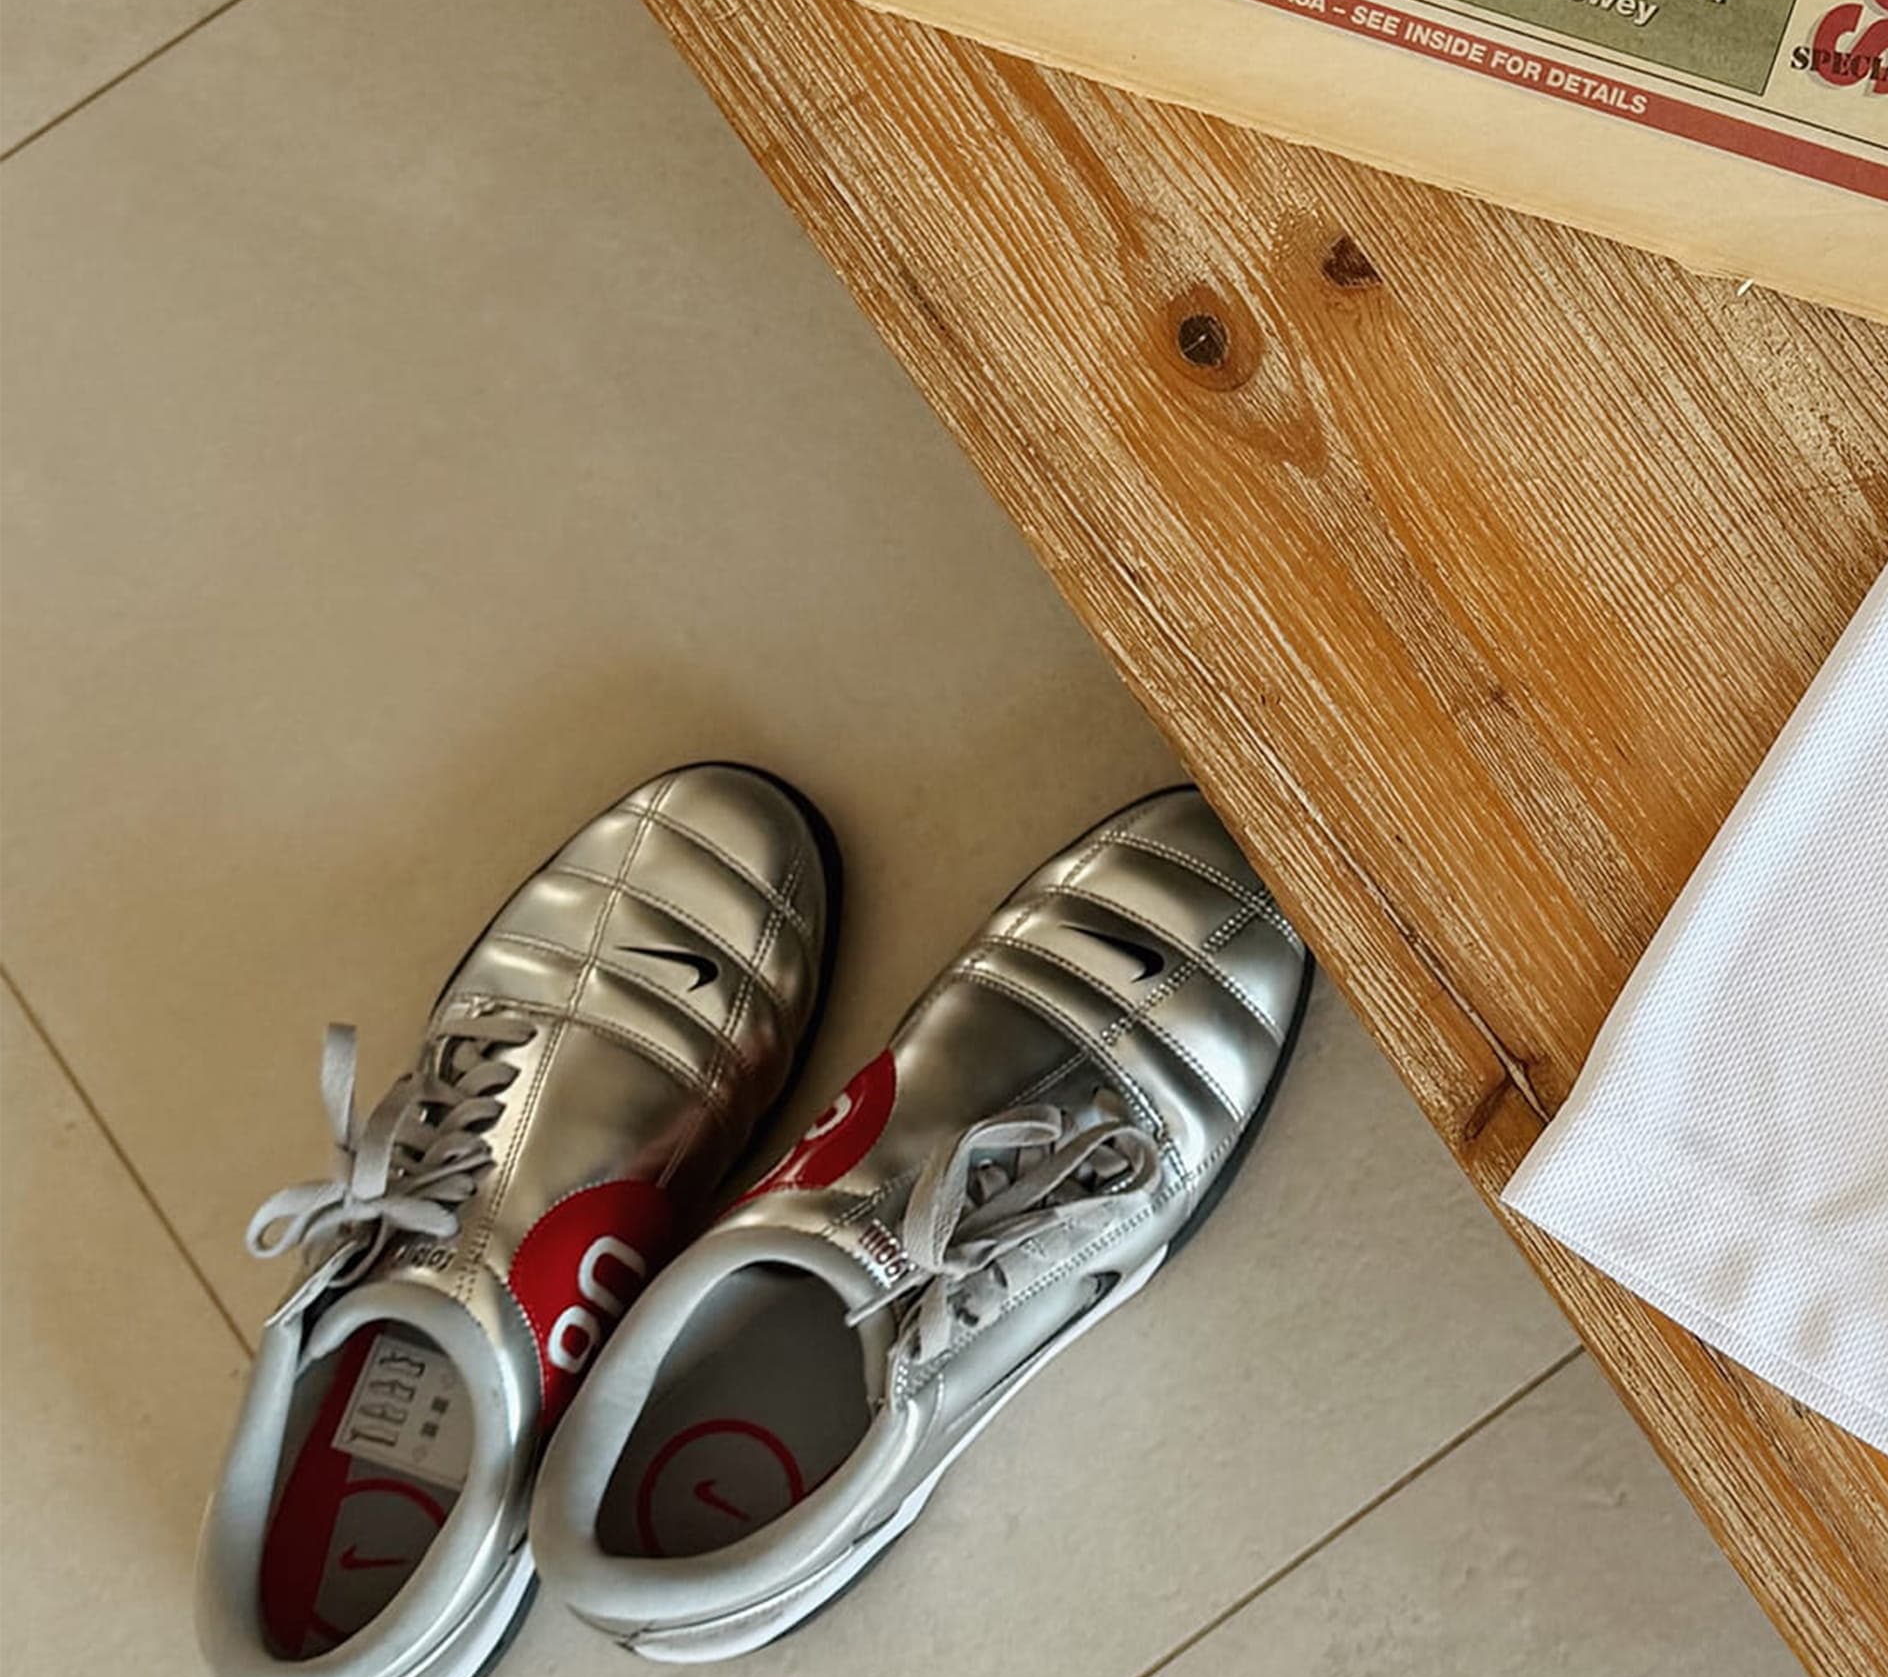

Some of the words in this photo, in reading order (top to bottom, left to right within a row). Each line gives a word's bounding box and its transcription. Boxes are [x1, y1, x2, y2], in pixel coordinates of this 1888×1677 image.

[1350, 5, 1402, 38] SEE
[1404, 22, 1486, 65] INSIDE
[1490, 49, 1544, 83] FOR
[1546, 66, 1649, 116] DETAILS
